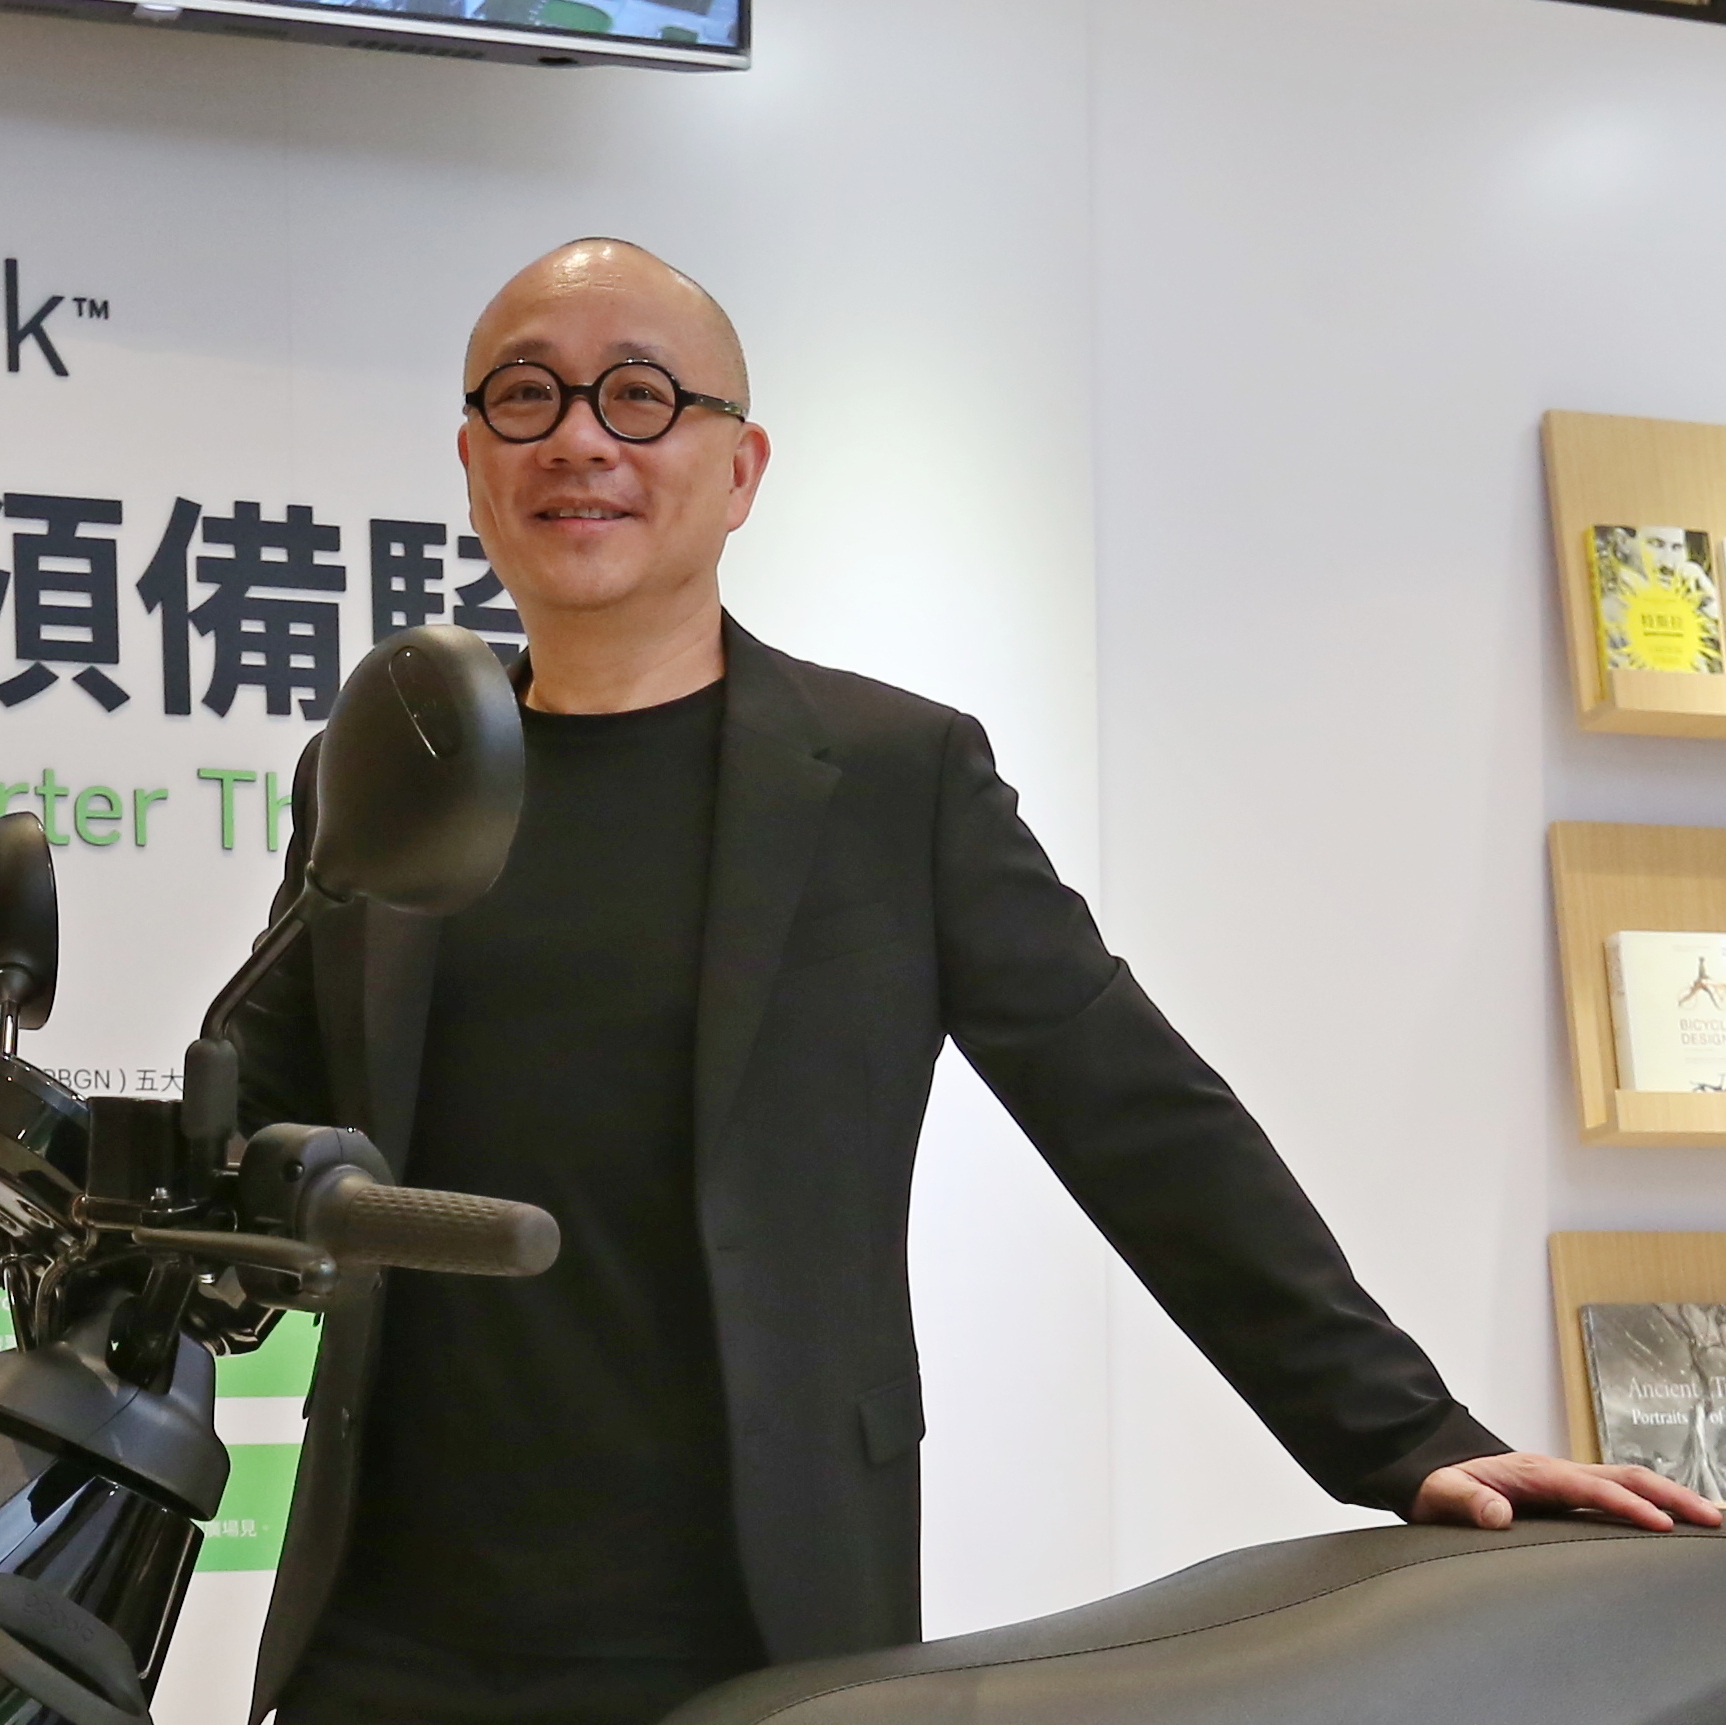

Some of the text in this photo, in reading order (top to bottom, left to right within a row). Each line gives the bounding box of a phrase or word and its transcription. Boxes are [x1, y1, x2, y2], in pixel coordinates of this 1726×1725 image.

[198, 768, 294, 852] Th
[135, 1069, 184, 1092] 五大
[1628, 1376, 1699, 1399] Ancient
[1631, 1408, 1689, 1425] Portraits
[1709, 1405, 1725, 1424] of
